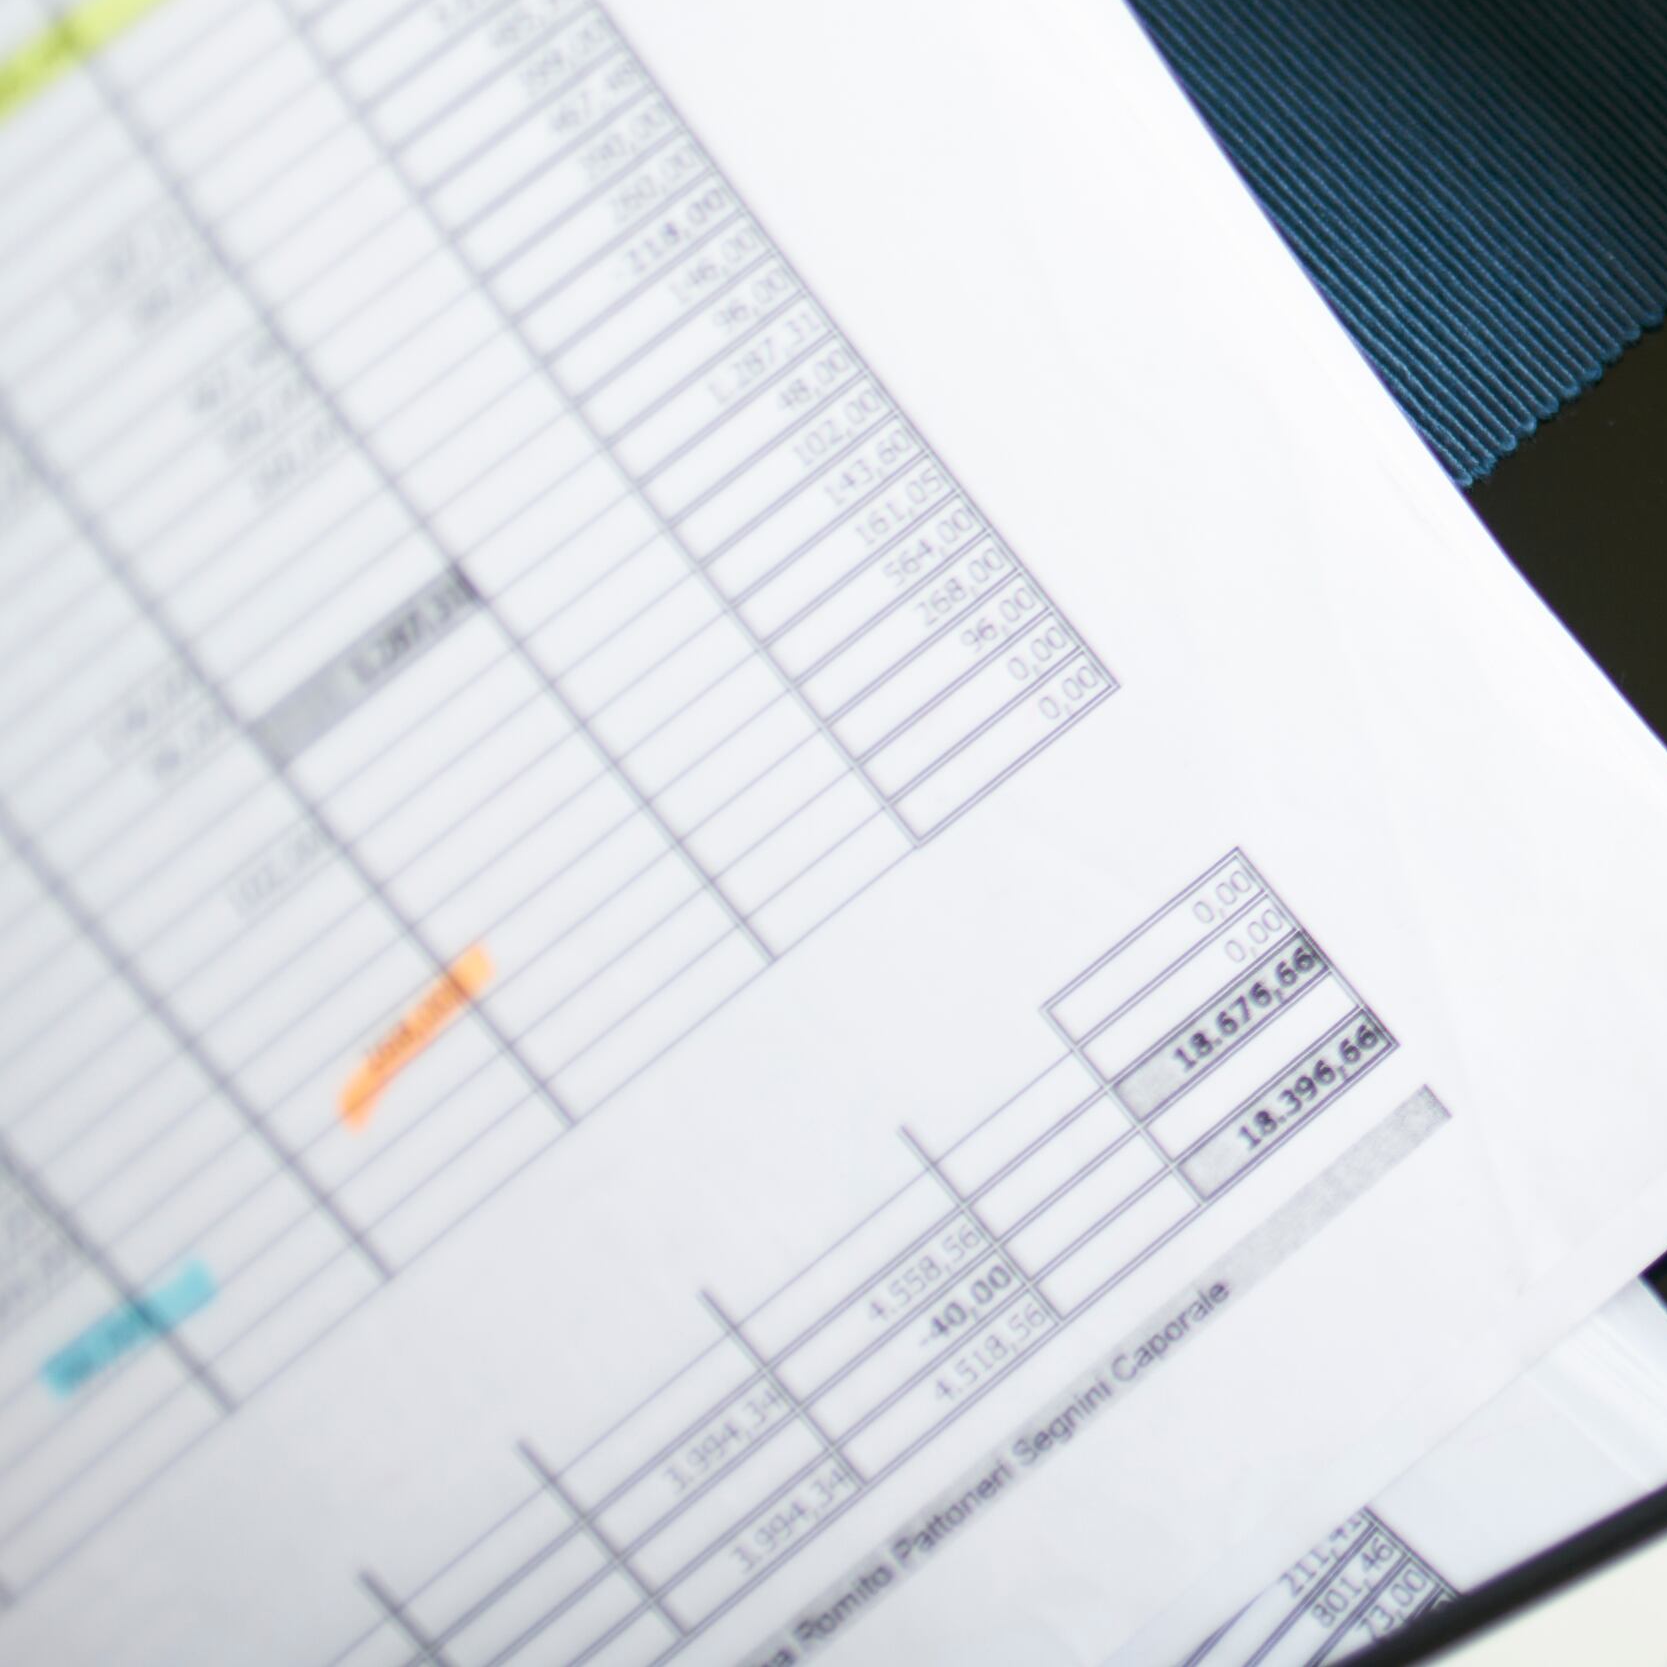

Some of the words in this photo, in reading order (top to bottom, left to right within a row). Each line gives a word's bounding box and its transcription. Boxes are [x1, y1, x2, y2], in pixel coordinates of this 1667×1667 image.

[774, 349, 851, 417] 48,00
[791, 388, 882, 468] 102,00
[822, 428, 913, 508] 143,60
[853, 467, 944, 547] 161,05
[883, 507, 976, 588] 564,00
[915, 546, 1007, 627] 268,00
[960, 586, 1038, 655] 96,00
[1007, 626, 1069, 684] 0,00
[1038, 665, 1101, 723] 0,00
[1191, 869, 1255, 927] 0,00
[1223, 908, 1286, 965] 0,00
[1171, 947, 1318, 1071] 18.676,66
[1235, 1025, 1382, 1149] 18.396,66
[863, 1223, 984, 1328] 4.558,56
[929, 1302, 1048, 1406] 4.518,56
[1012, 1377, 1116, 1470] Segnini
[1108, 1277, 1235, 1387] Caporale
[1310, 1536, 1395, 1627] 801,46
